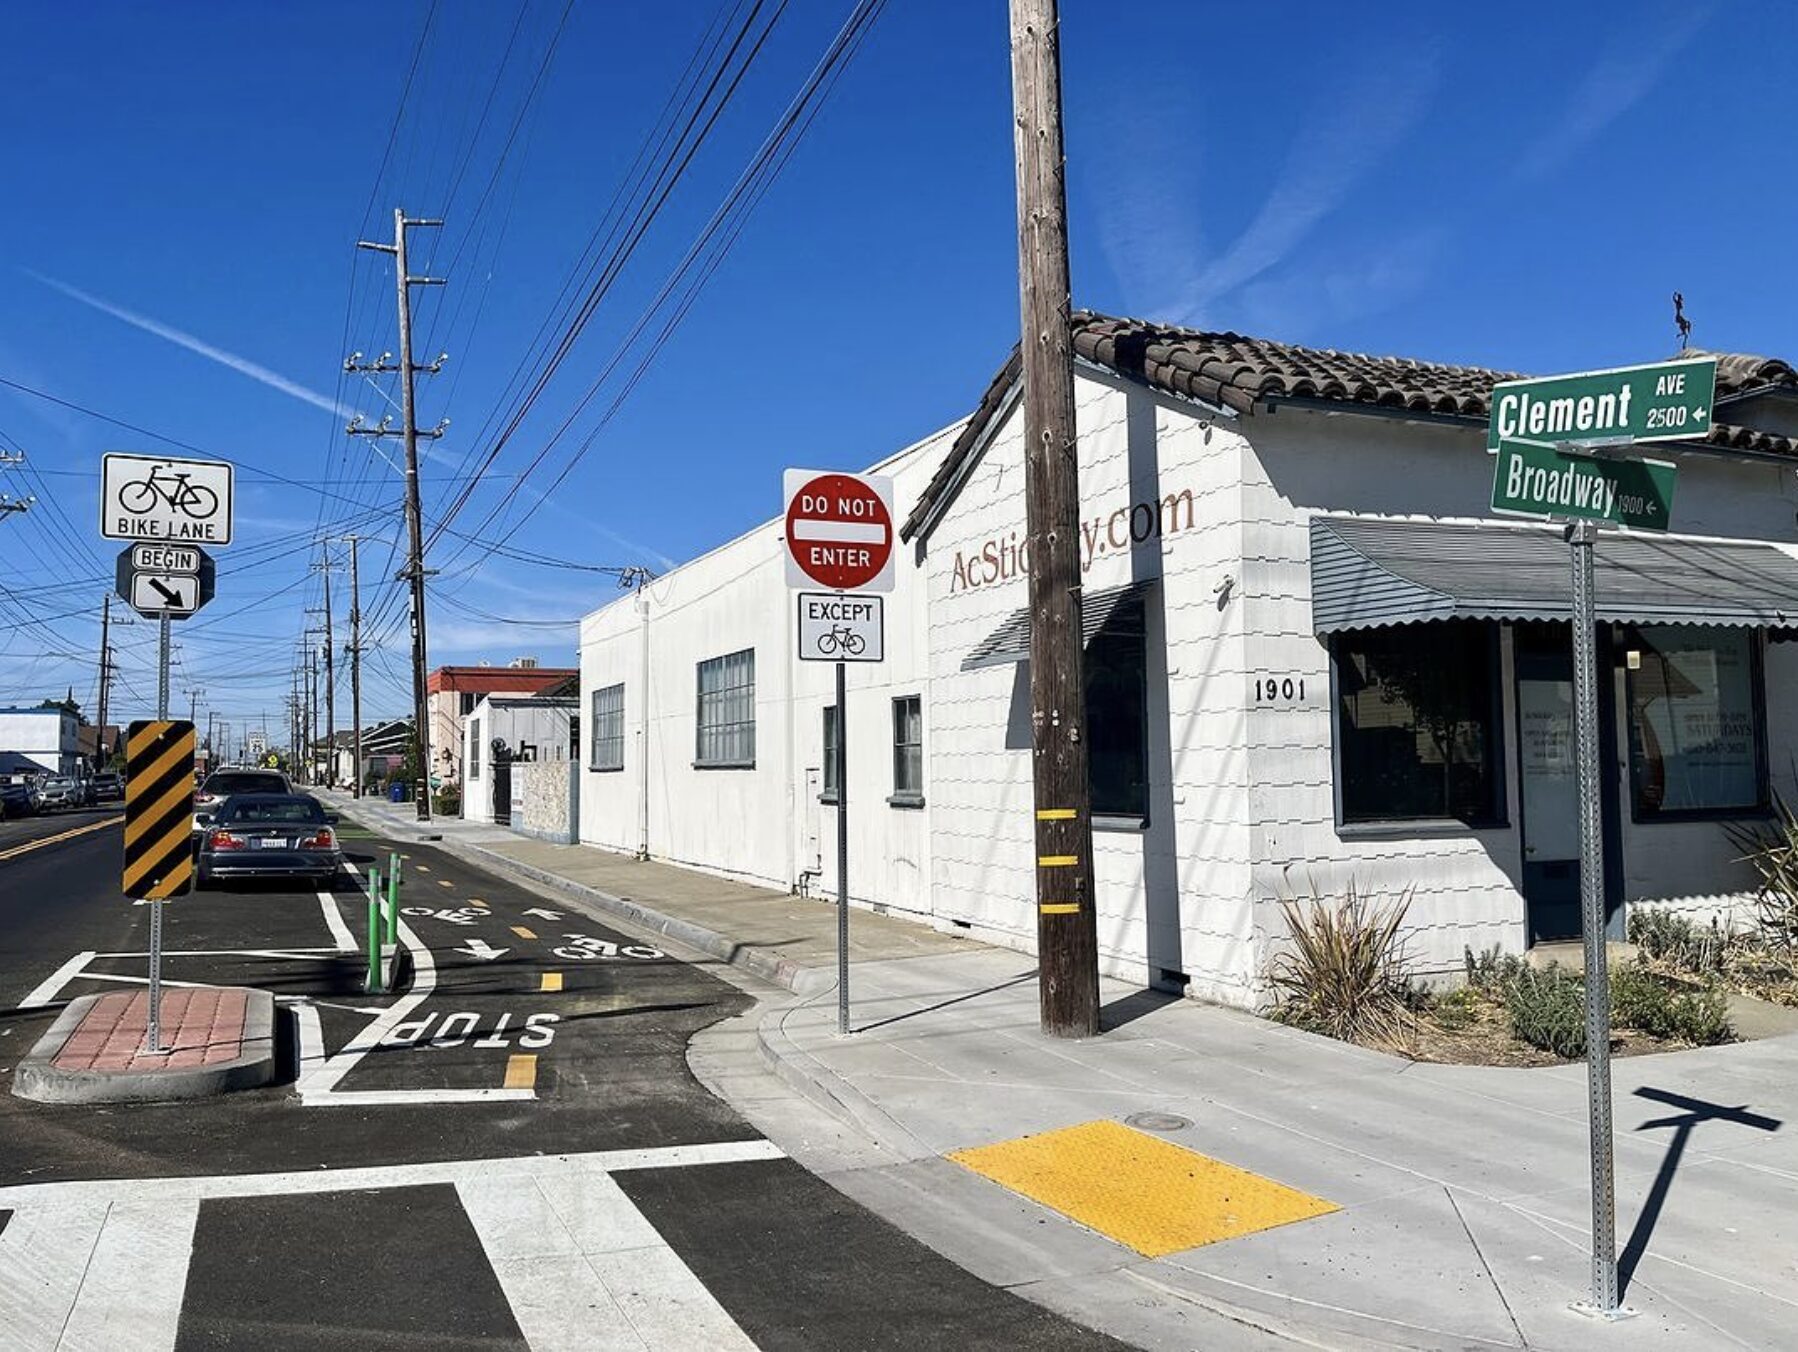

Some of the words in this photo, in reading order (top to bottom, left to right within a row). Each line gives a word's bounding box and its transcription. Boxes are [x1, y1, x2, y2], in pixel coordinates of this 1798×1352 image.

[1498, 384, 1632, 438] Clement
[1655, 373, 1686, 396] AVE
[1646, 406, 1687, 429] 2500
[1506, 453, 1618, 518] Broadway
[1617, 495, 1644, 515] 1900
[802, 495, 828, 514] DO
[839, 498, 876, 517] NOT
[118, 518, 160, 536] BIKE
[168, 521, 215, 540] LANE
[142, 550, 192, 568] BEGIN
[811, 547, 870, 567] ENTER
[809, 602, 873, 621] EXCEPT
[1255, 678, 1305, 702] 1901
[379, 1011, 561, 1049] STOP
